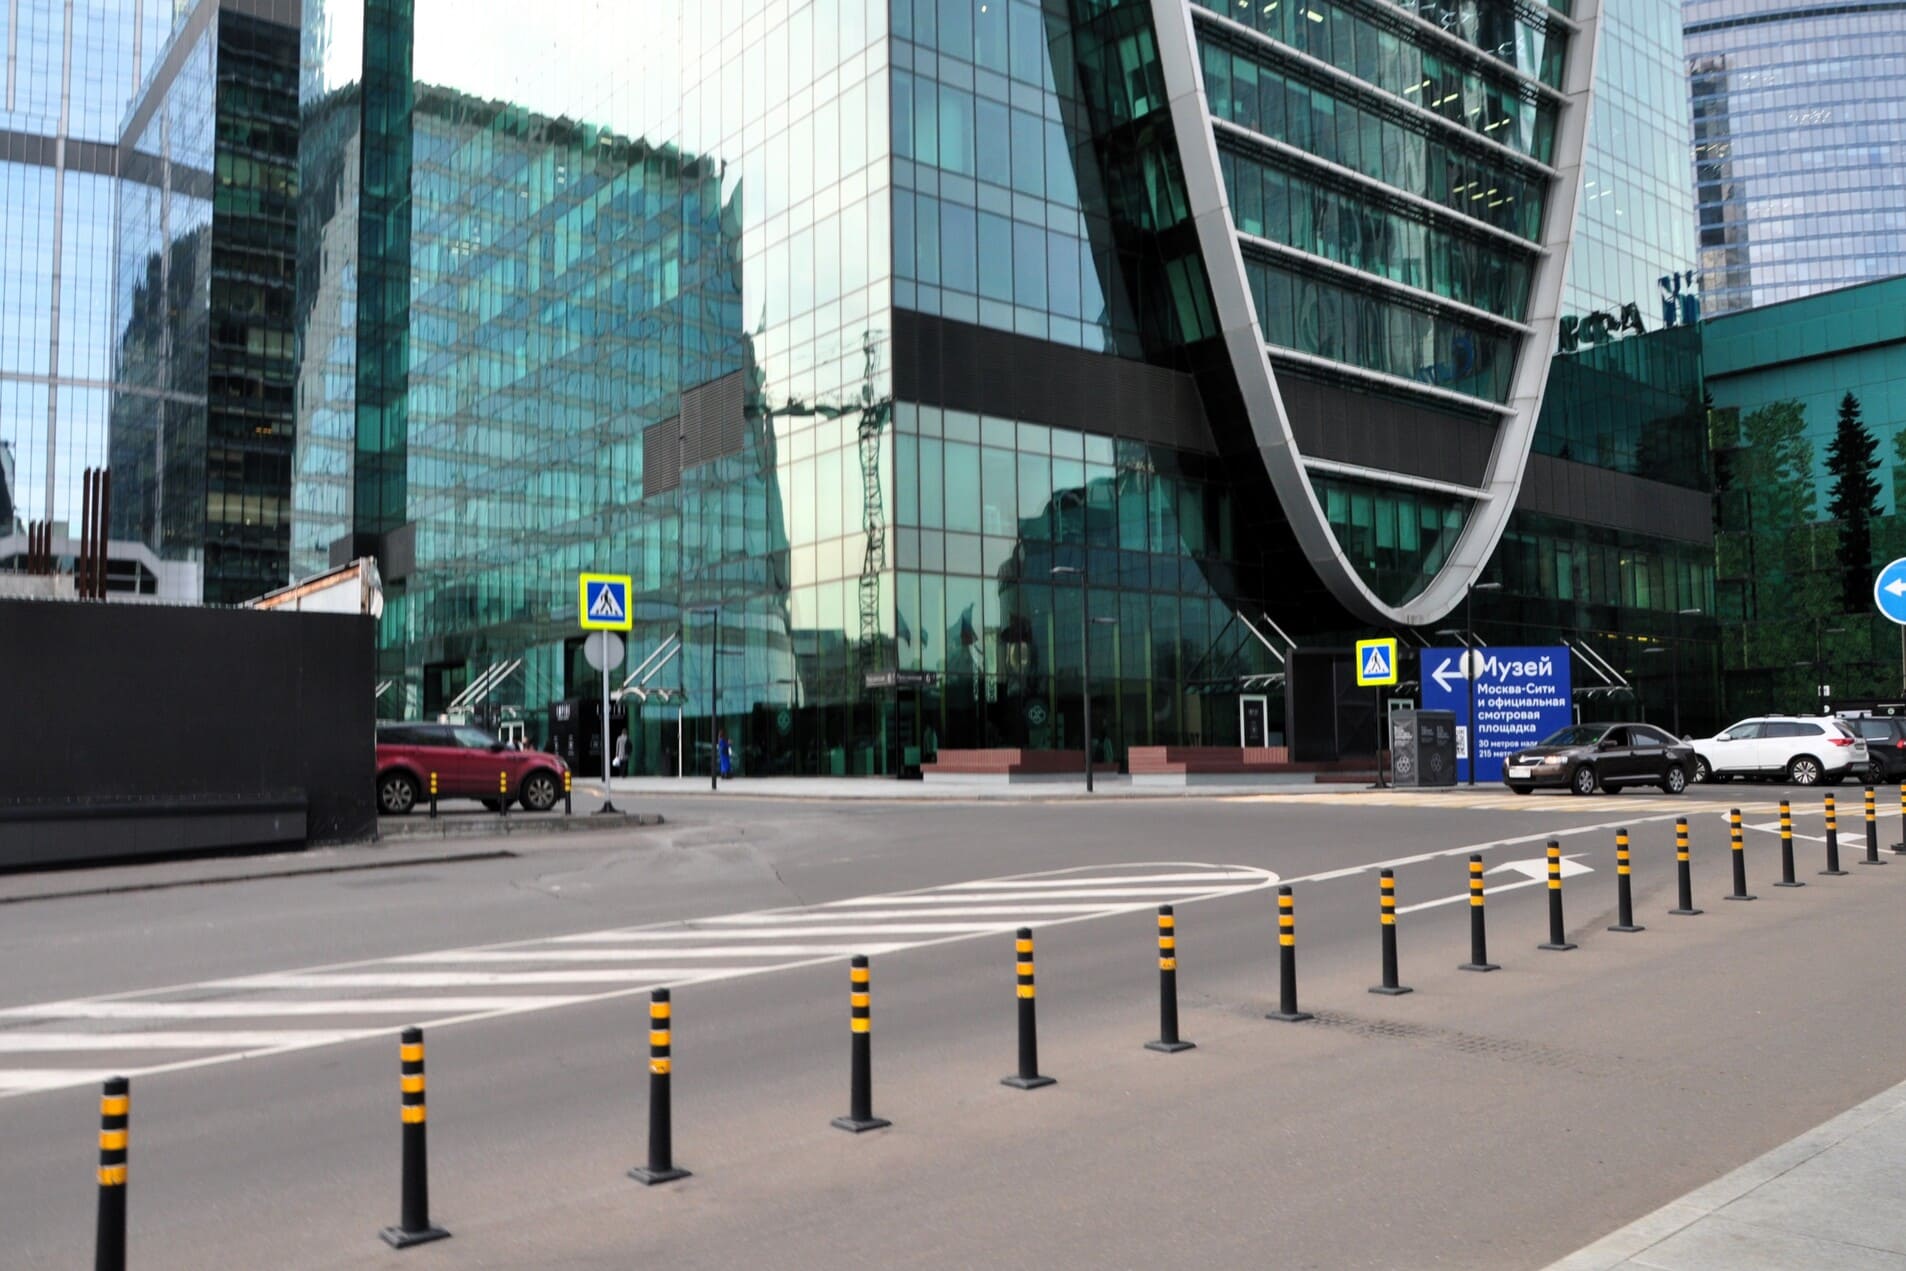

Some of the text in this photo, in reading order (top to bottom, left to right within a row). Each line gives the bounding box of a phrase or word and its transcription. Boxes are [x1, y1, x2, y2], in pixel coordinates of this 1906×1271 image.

[1484, 656, 1552, 682] Музей
[1477, 683, 1556, 694] Москва-Сити
[1478, 697, 1565, 710] и официальная
[1478, 711, 1541, 722] смотровая
[1479, 724, 1537, 734] площадка
[1479, 740, 1489, 748] 30
[1491, 741, 1519, 749] метров
[1479, 750, 1491, 758] 215
